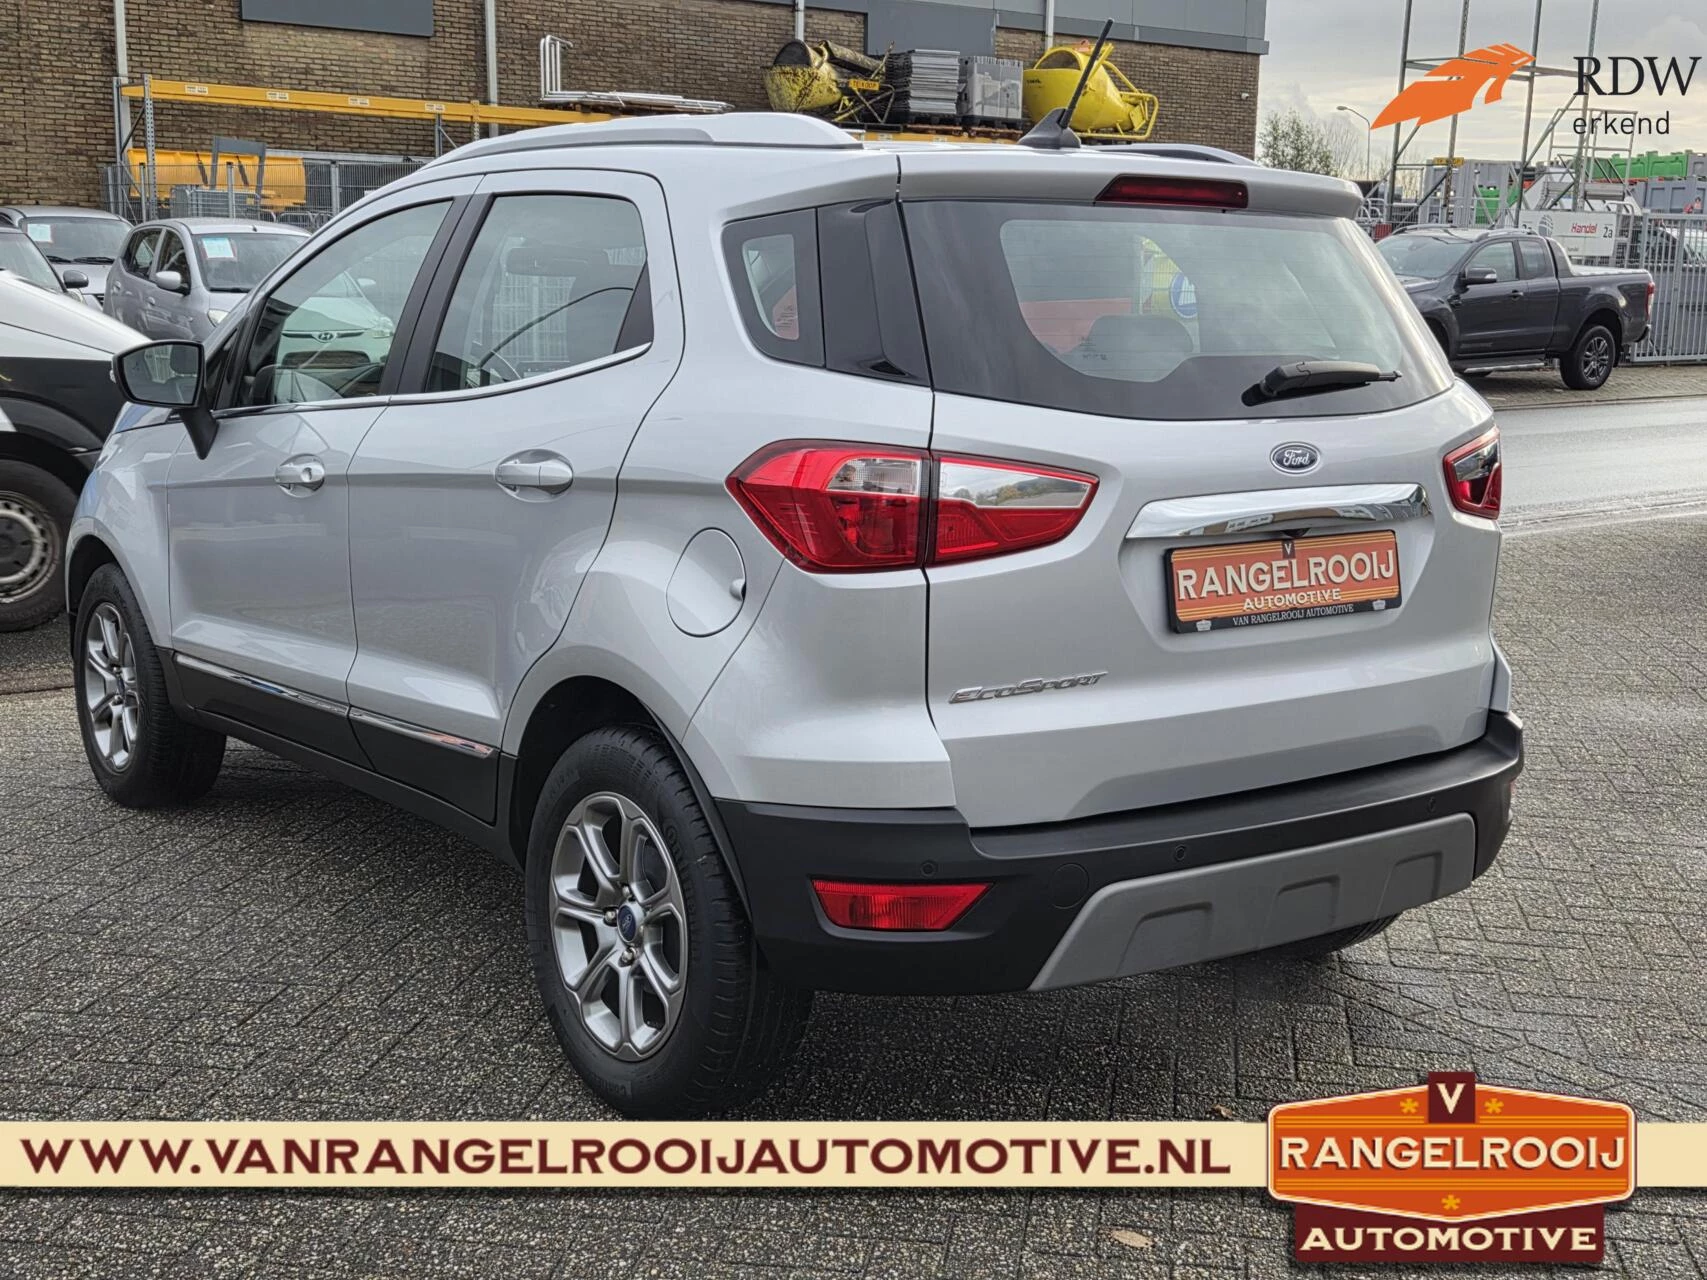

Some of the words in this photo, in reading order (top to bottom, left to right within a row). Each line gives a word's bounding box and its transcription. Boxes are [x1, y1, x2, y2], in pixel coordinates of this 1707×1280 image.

[1571, 223, 1598, 233] Handel
[1603, 226, 1613, 238] 2a
[1283, 449, 1310, 466] Ford
[1284, 543, 1292, 555] V
[1177, 550, 1394, 600] RANGELROOIJ
[1243, 588, 1341, 610] AUTOMOTIVE
[1233, 615, 1250, 626] VAN
[1250, 609, 1304, 624] RANGELROOIJ
[1306, 603, 1354, 618] AUTOMOTIVE
